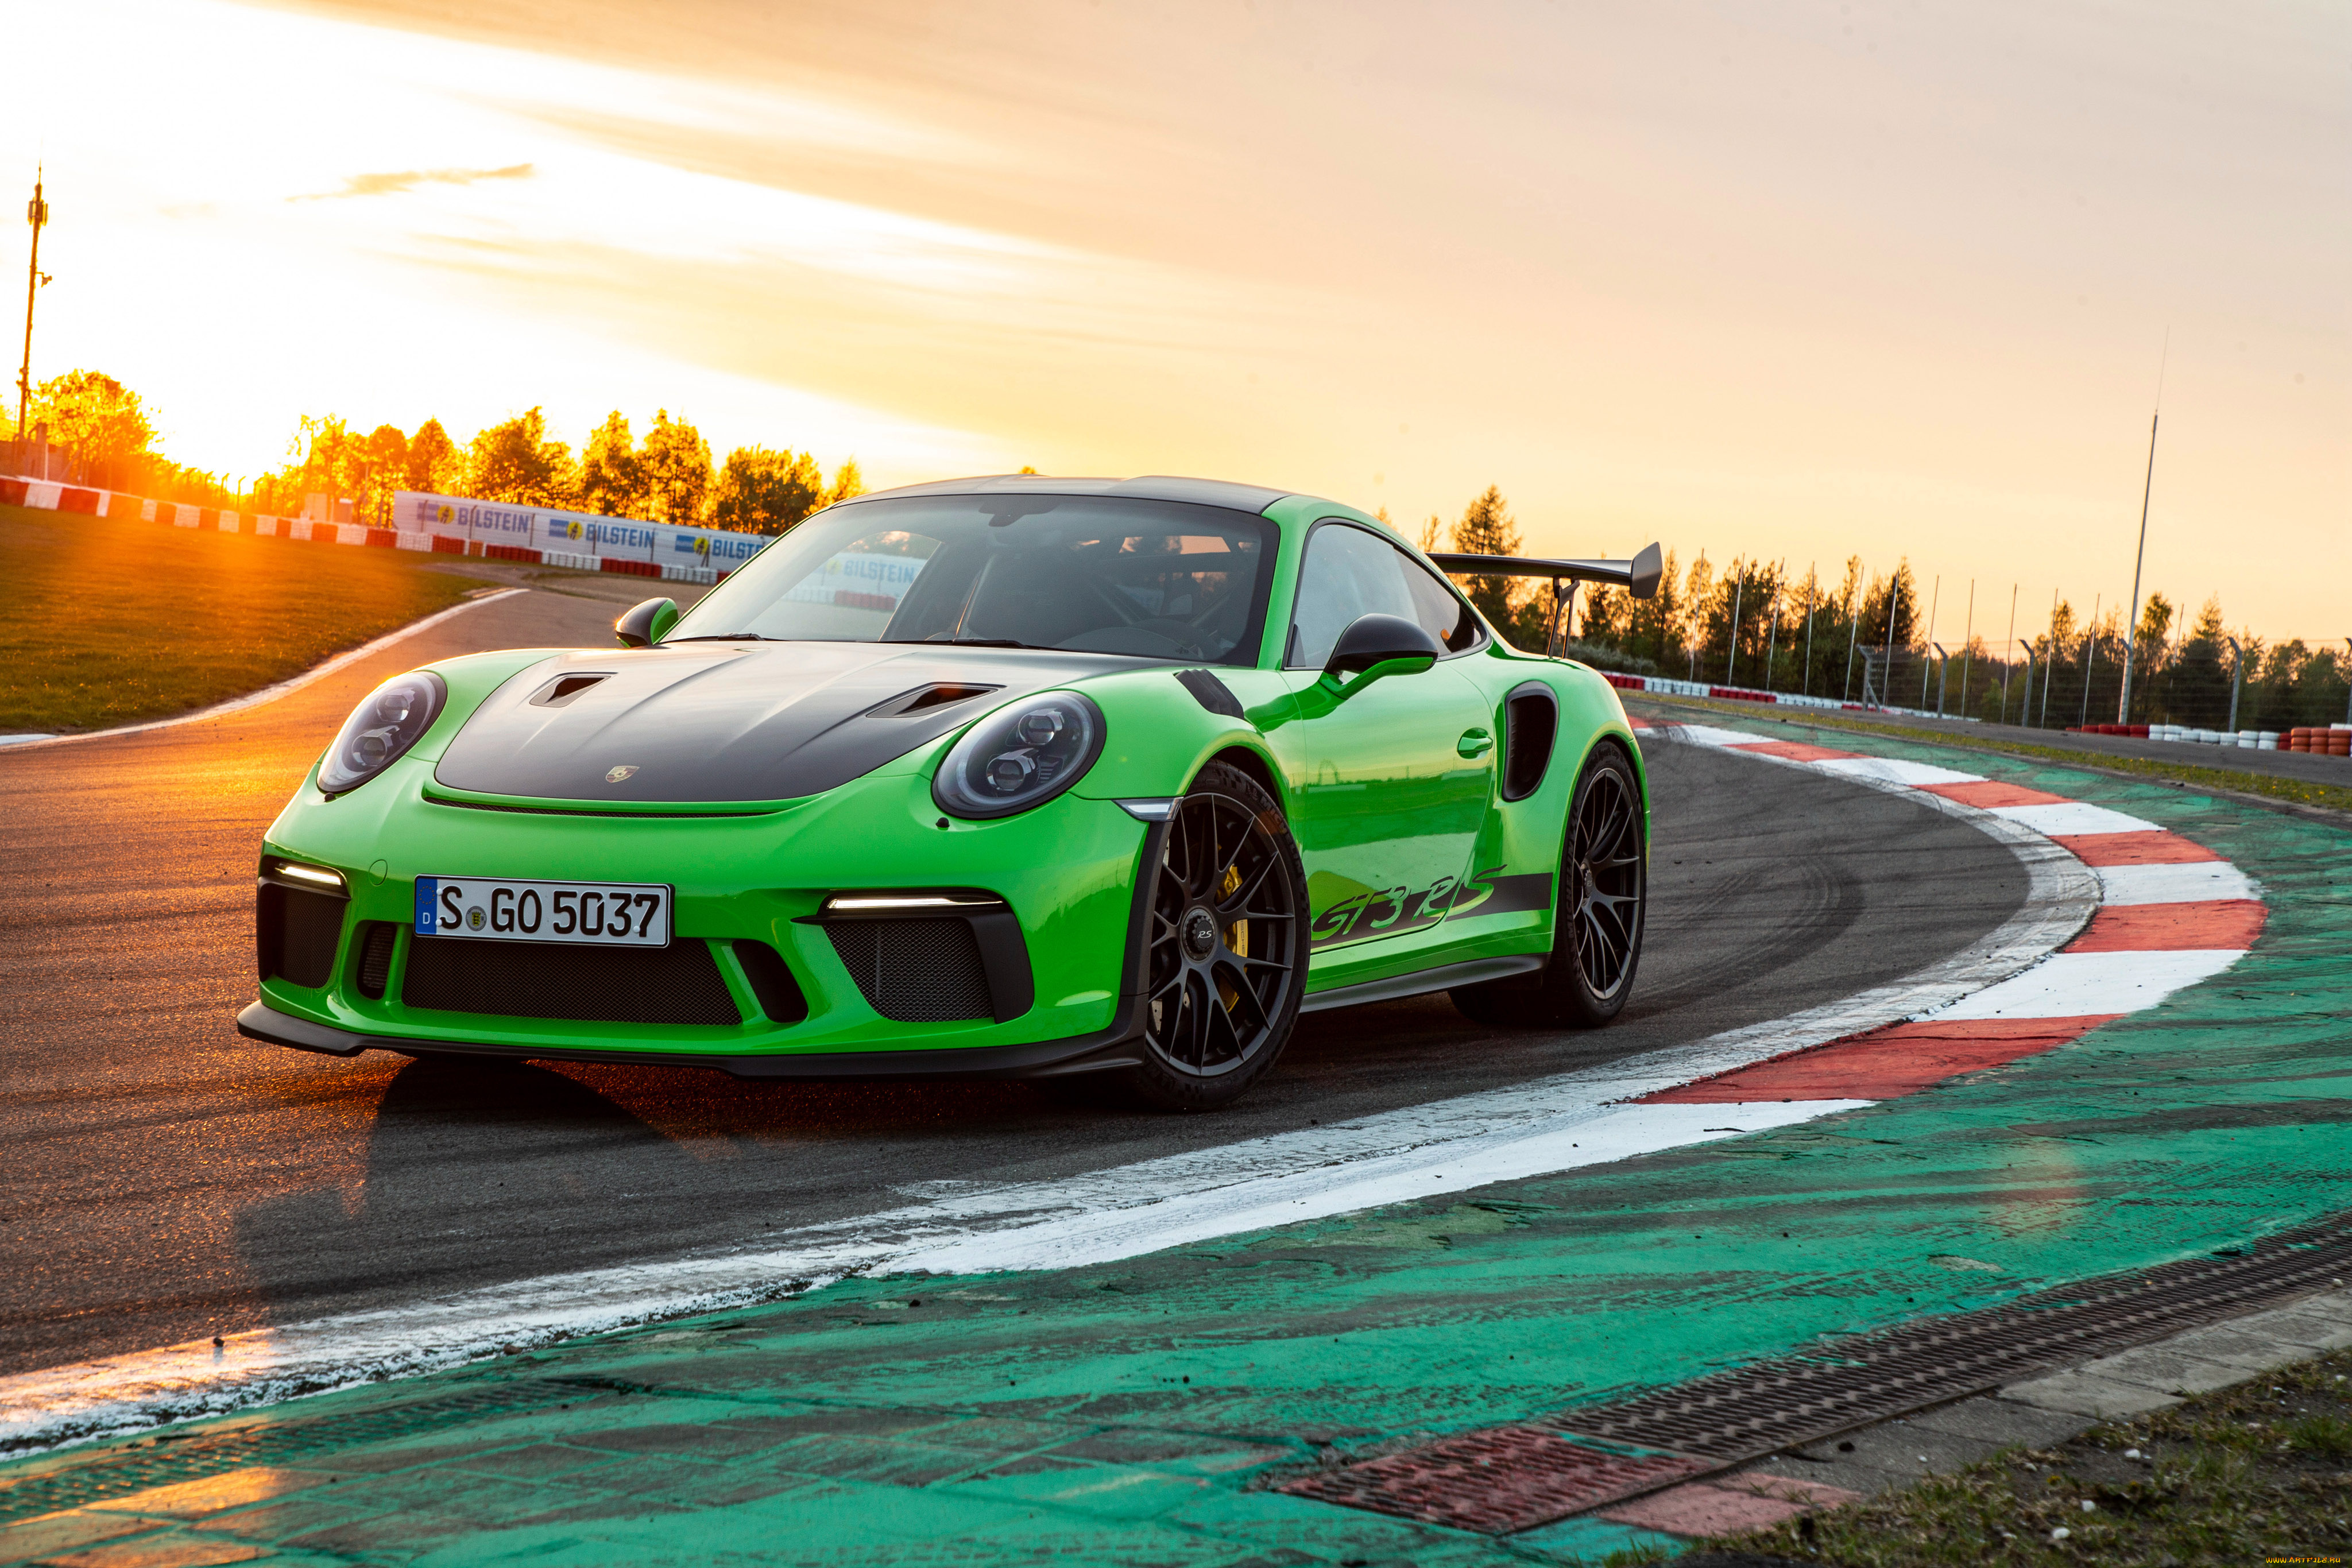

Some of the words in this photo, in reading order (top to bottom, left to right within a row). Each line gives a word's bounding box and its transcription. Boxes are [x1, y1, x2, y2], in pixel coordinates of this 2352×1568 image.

[586, 523, 655, 548] BILSTEIN
[844, 560, 915, 583] BILSTEIN
[1259, 795, 1303, 875] MICHELIN
[1411, 864, 1508, 922] RS
[422, 912, 430, 924] D
[440, 885, 463, 930] S
[490, 888, 543, 934] GO
[552, 890, 661, 938] 5037
[1197, 930, 1212, 939] RS
